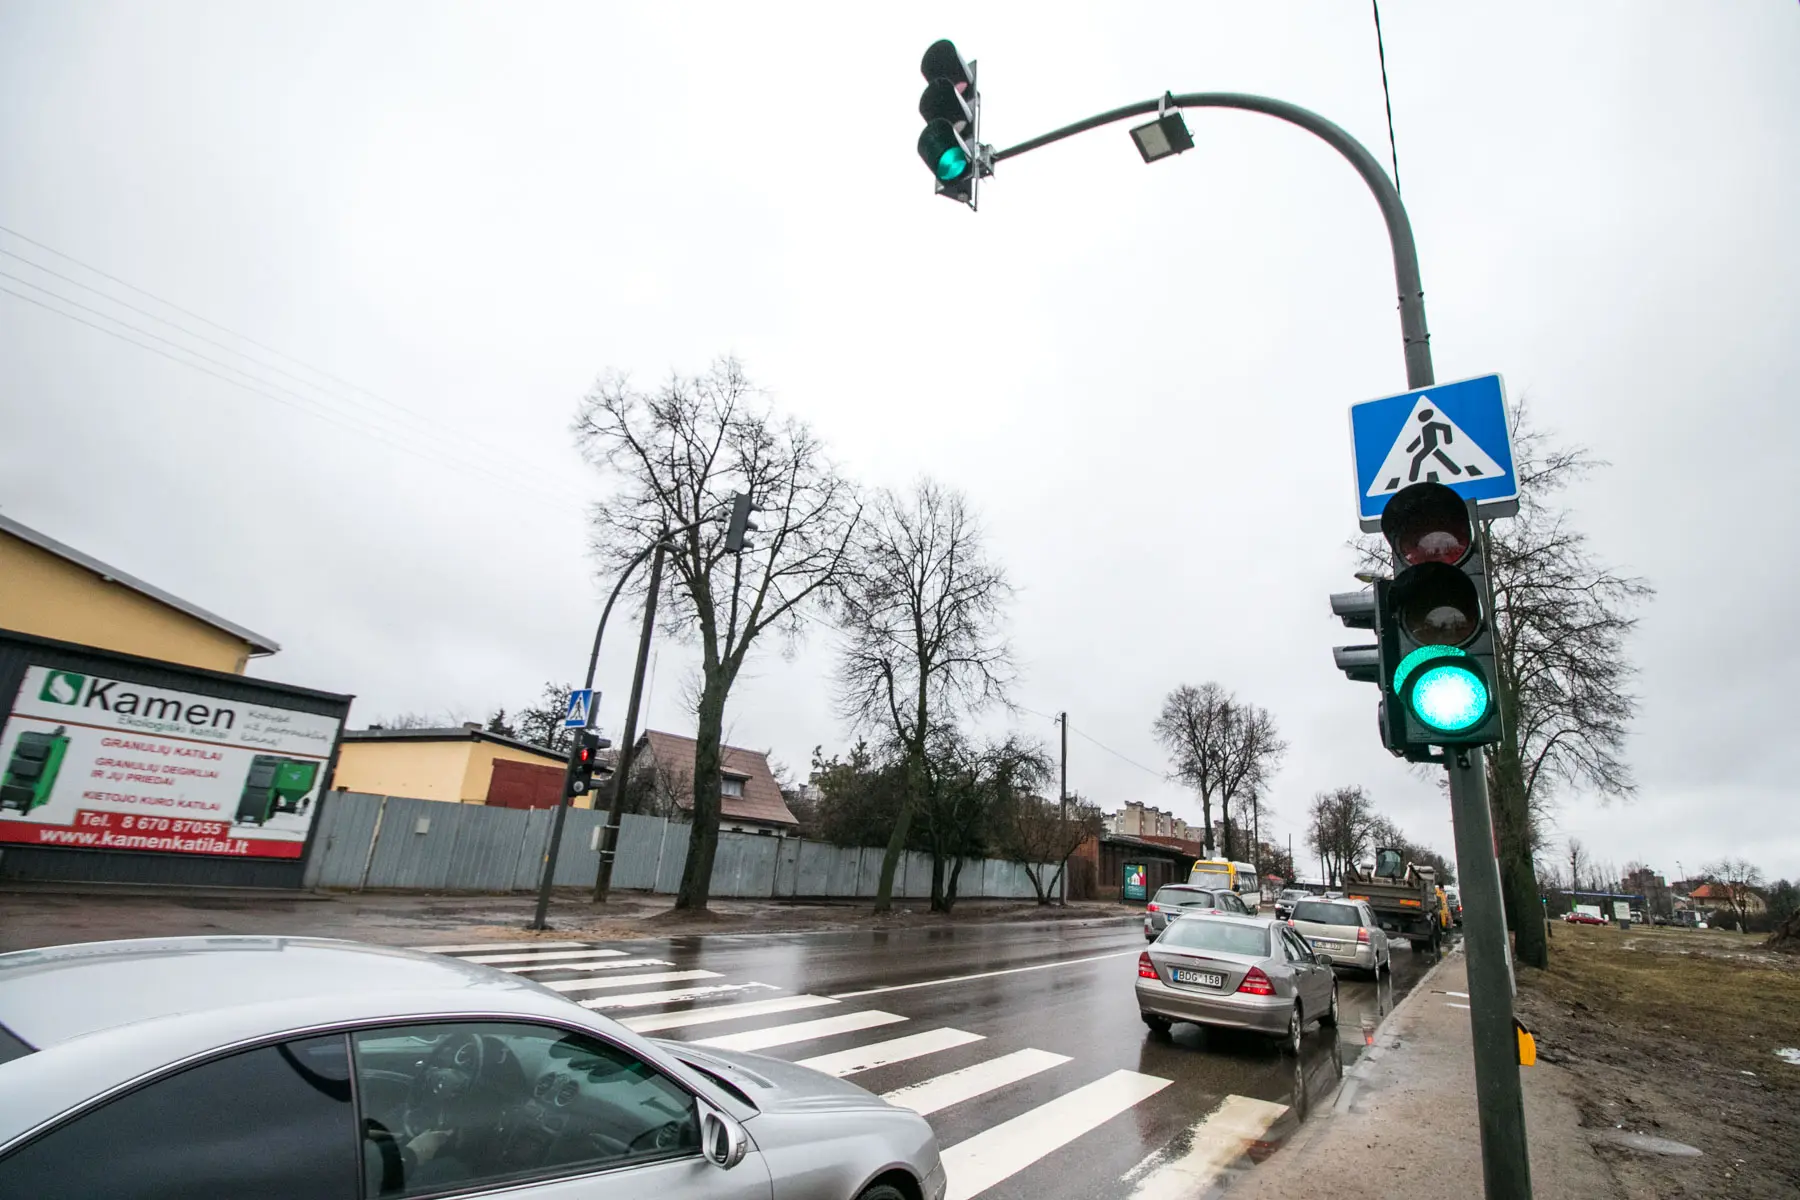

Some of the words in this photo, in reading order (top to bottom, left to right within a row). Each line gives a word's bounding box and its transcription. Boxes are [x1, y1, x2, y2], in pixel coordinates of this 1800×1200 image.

[84, 678, 236, 729] Kamen
[189, 725, 229, 739] katilai
[101, 737, 171, 755] GRANULIŲ
[174, 747, 223, 761] KATILAI
[90, 769, 104, 778] IR
[126, 773, 174, 785] PRIEDAI
[162, 765, 220, 778] DEGIKLIAI
[82, 790, 137, 803] KIETOJO
[140, 797, 174, 806] KURO
[177, 799, 222, 811] KATILAI
[80, 811, 111, 827] Tel.
[120, 816, 133, 829] 8
[138, 817, 168, 831] 670
[172, 820, 222, 835] 87055
[39, 829, 249, 854] www.kamenkatilai.lt
[1178, 970, 1198, 982] BDG
[1204, 974, 1220, 985] 158
